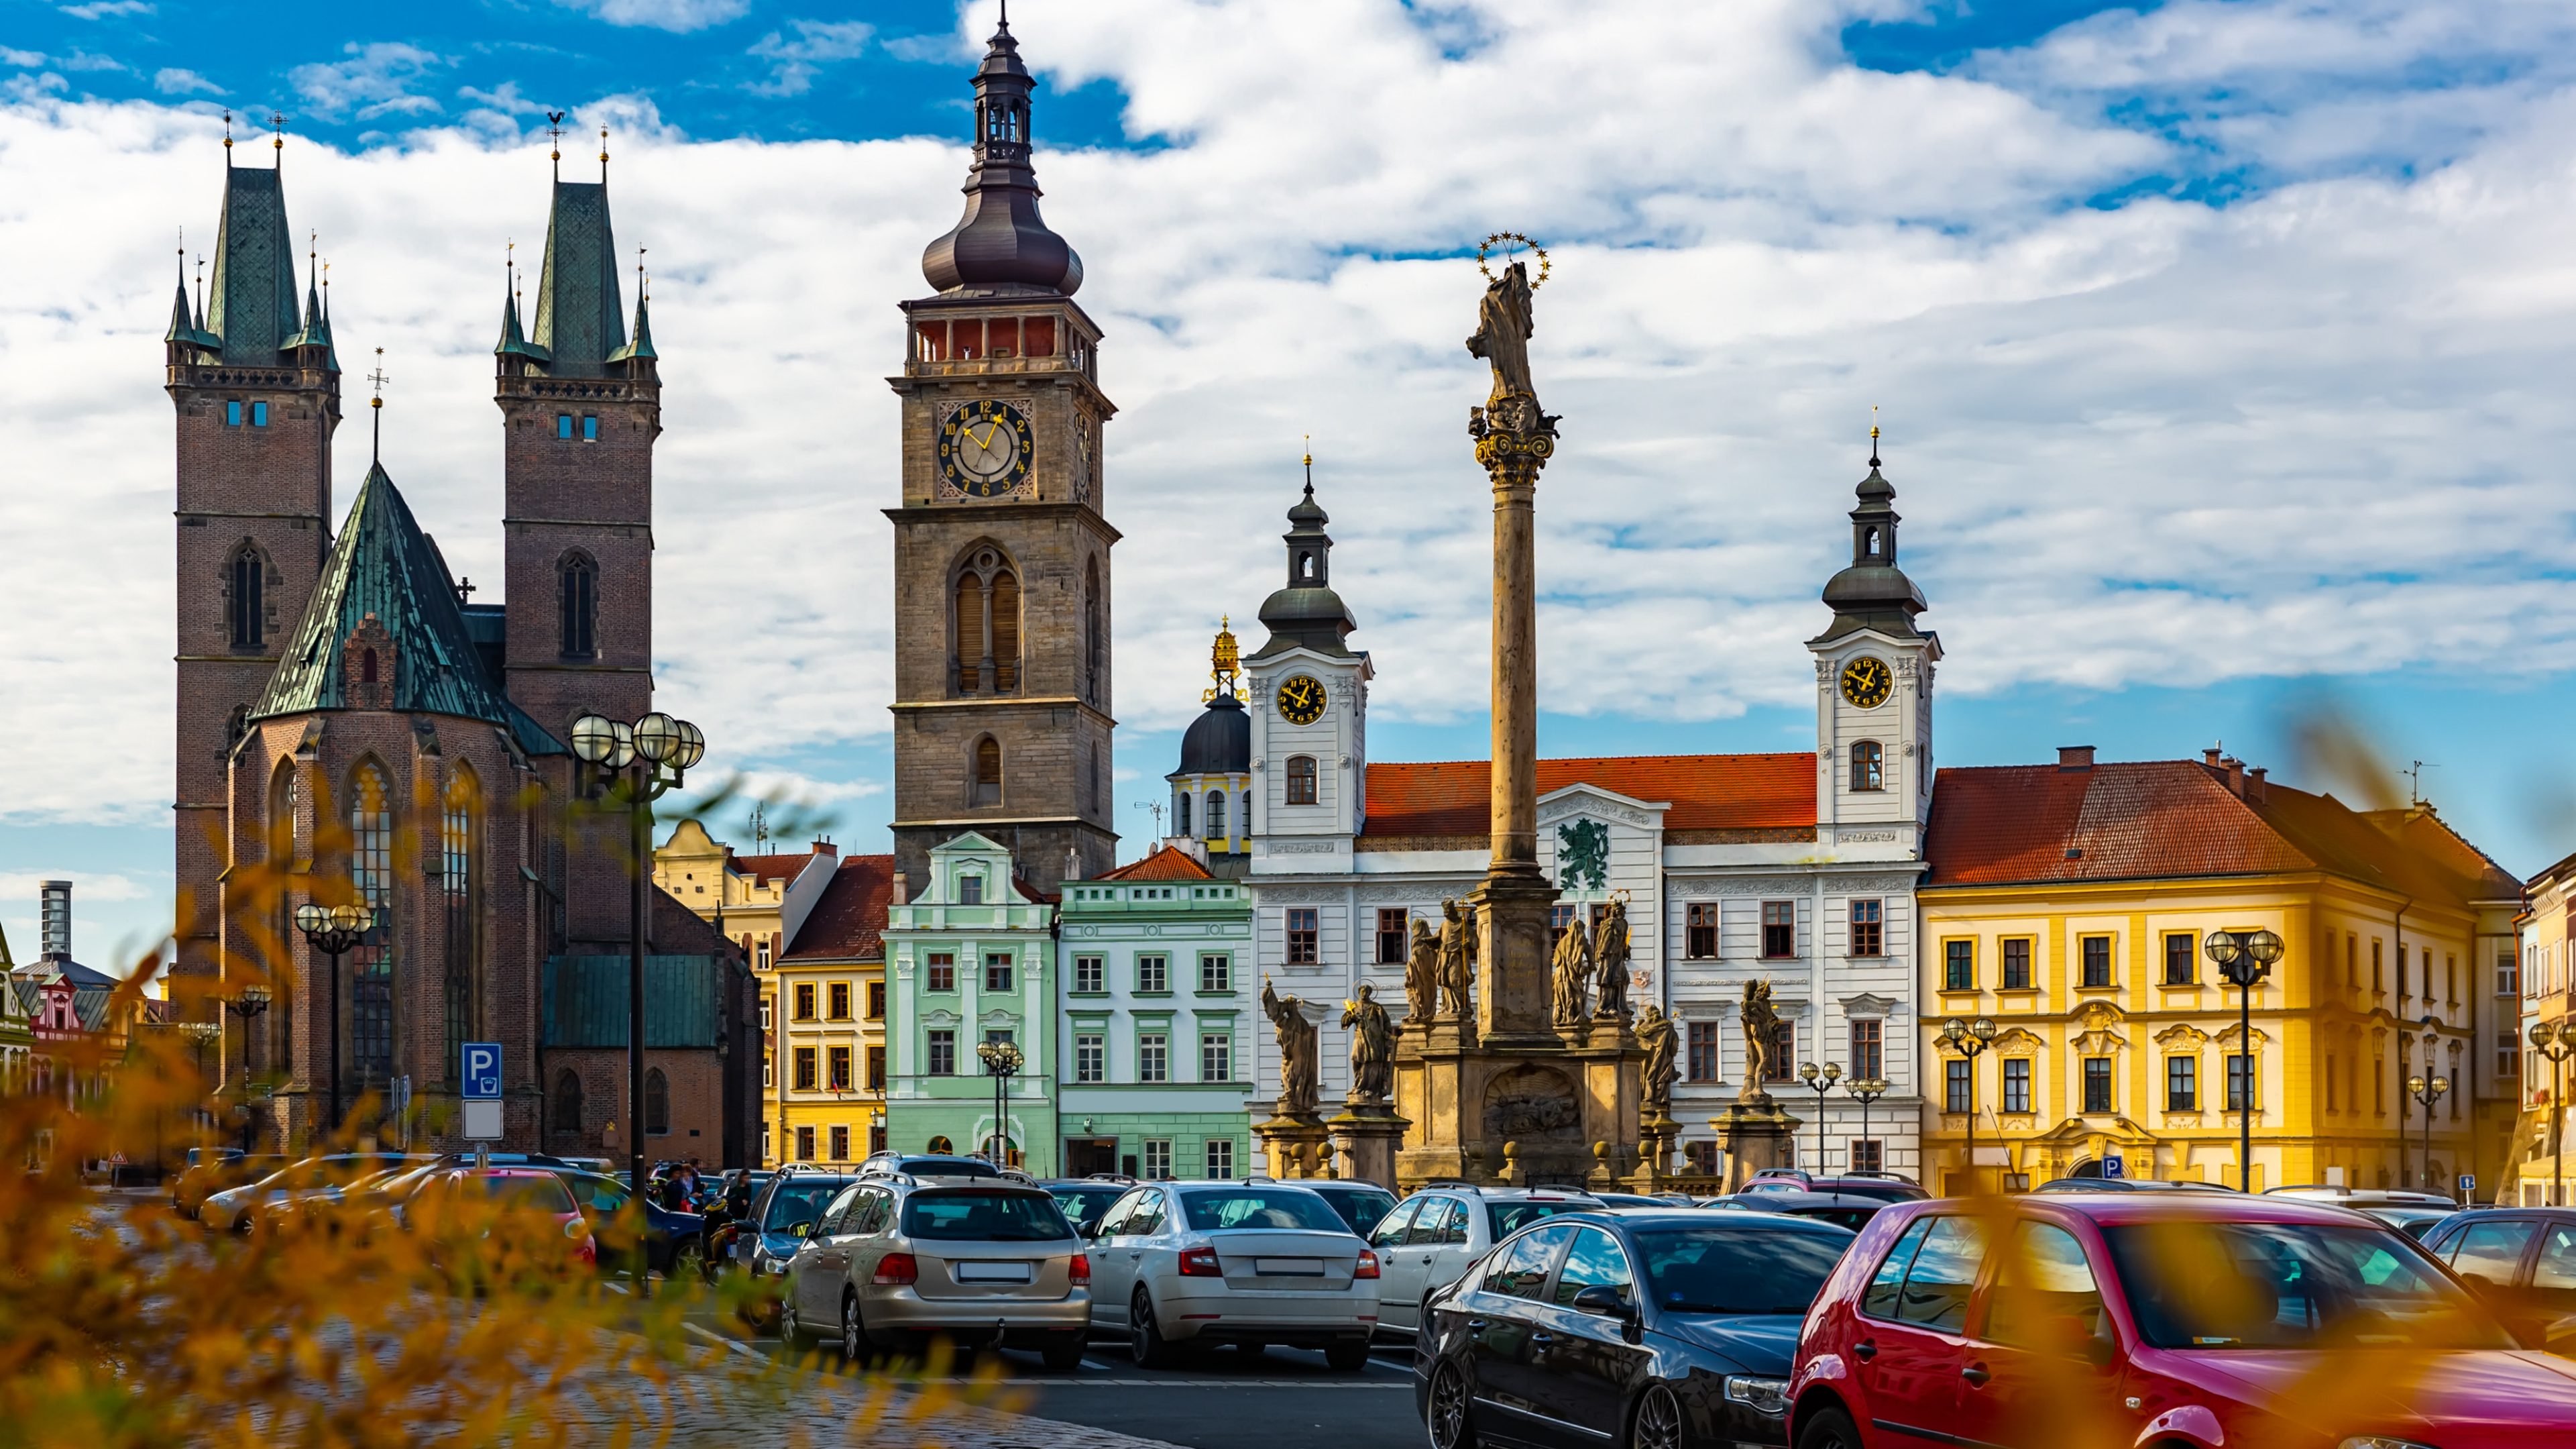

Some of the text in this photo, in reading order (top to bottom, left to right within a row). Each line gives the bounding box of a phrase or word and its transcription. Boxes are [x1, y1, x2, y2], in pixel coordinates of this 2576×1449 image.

[979, 401, 991, 413] 12
[1003, 406, 1007, 417] 1
[960, 408, 968, 420] 11
[946, 423, 956, 435] 10
[1017, 420, 1025, 432] 2
[941, 443, 948, 456] 9
[1022, 441, 1029, 453] 3
[947, 465, 954, 477] 8
[1017, 461, 1025, 473] 4
[962, 479, 970, 492] 7
[982, 483, 989, 496] 6
[1003, 477, 1010, 490] 5
[471, 1051, 492, 1080] P
[2107, 1160, 2117, 1176] P
